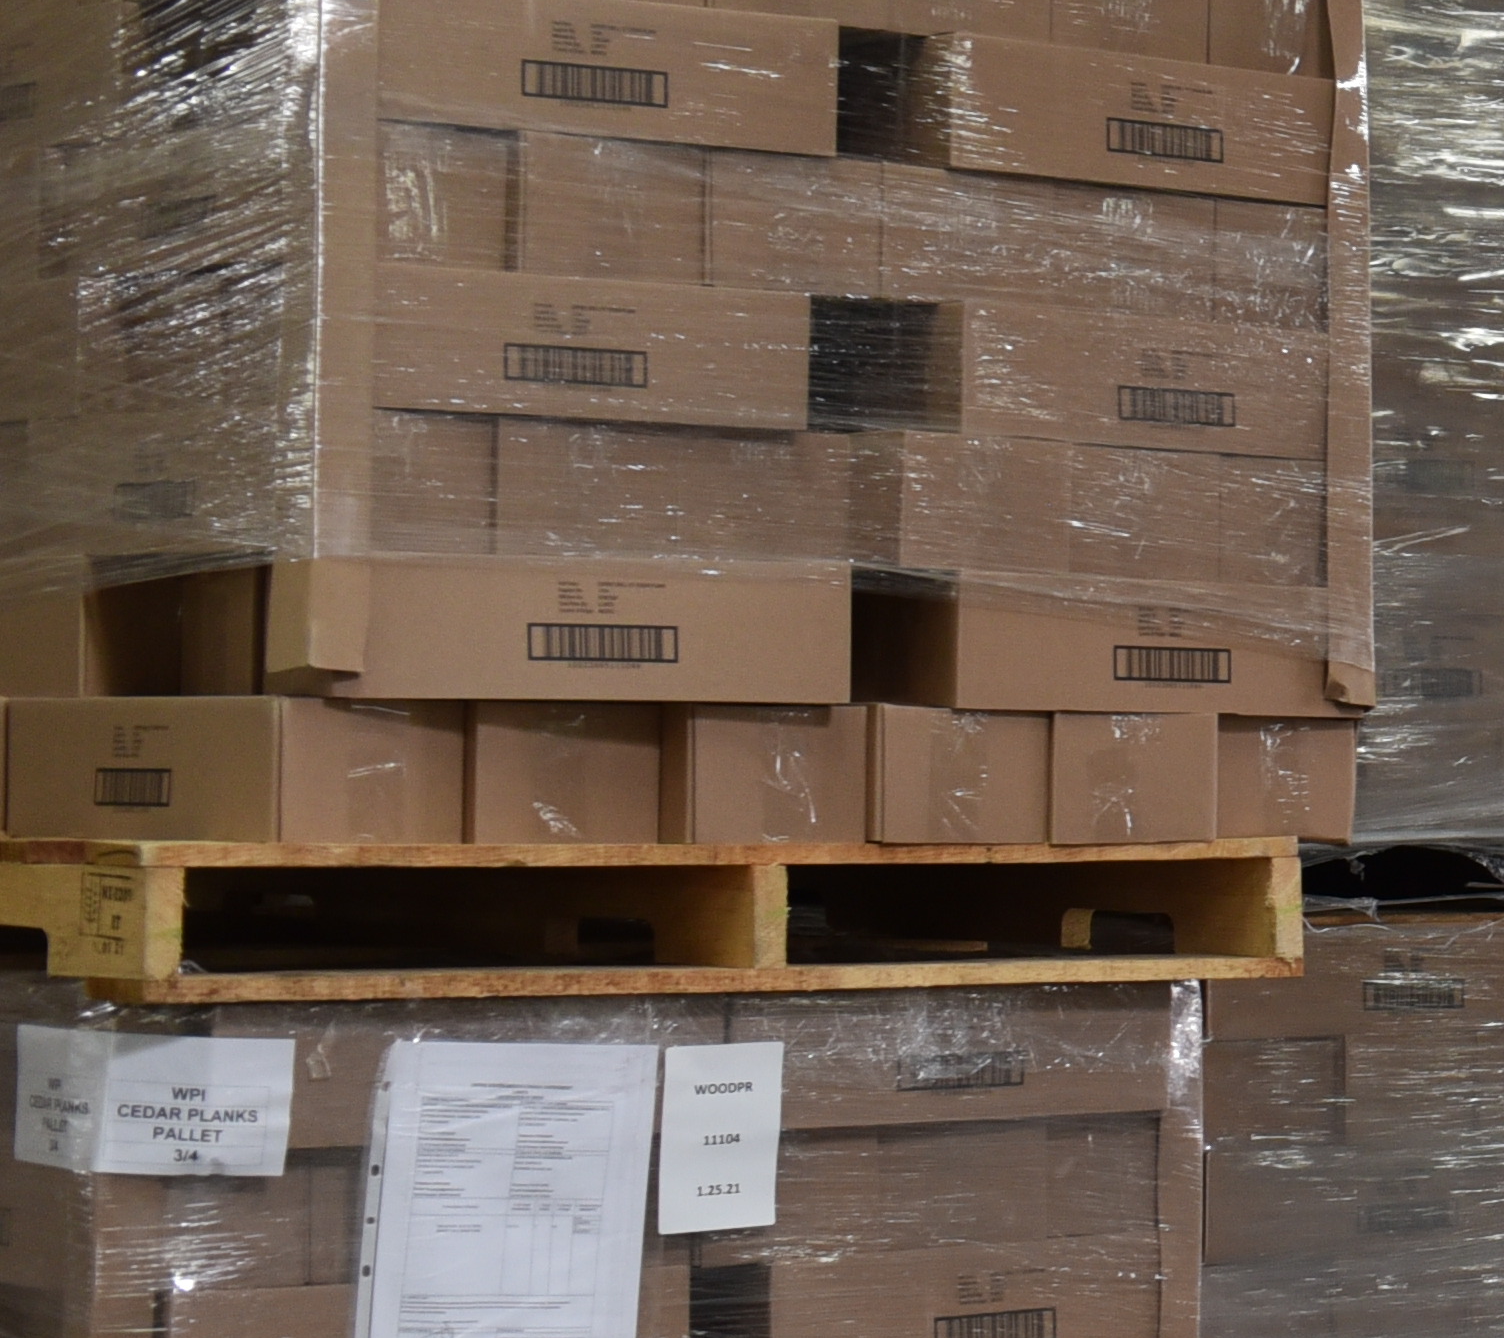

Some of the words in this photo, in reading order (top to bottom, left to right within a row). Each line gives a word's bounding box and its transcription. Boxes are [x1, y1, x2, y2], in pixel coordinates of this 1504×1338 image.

[172, 1087, 206, 1101] WPI
[695, 1082, 753, 1095] WOODPR
[118, 1104, 181, 1120] CEDAR
[188, 1108, 258, 1123] PLANKS
[152, 1127, 222, 1142] PALLET
[703, 1133, 740, 1145] 11104
[174, 1149, 199, 1161] 3/4
[697, 1183, 741, 1197] 1.25.21
